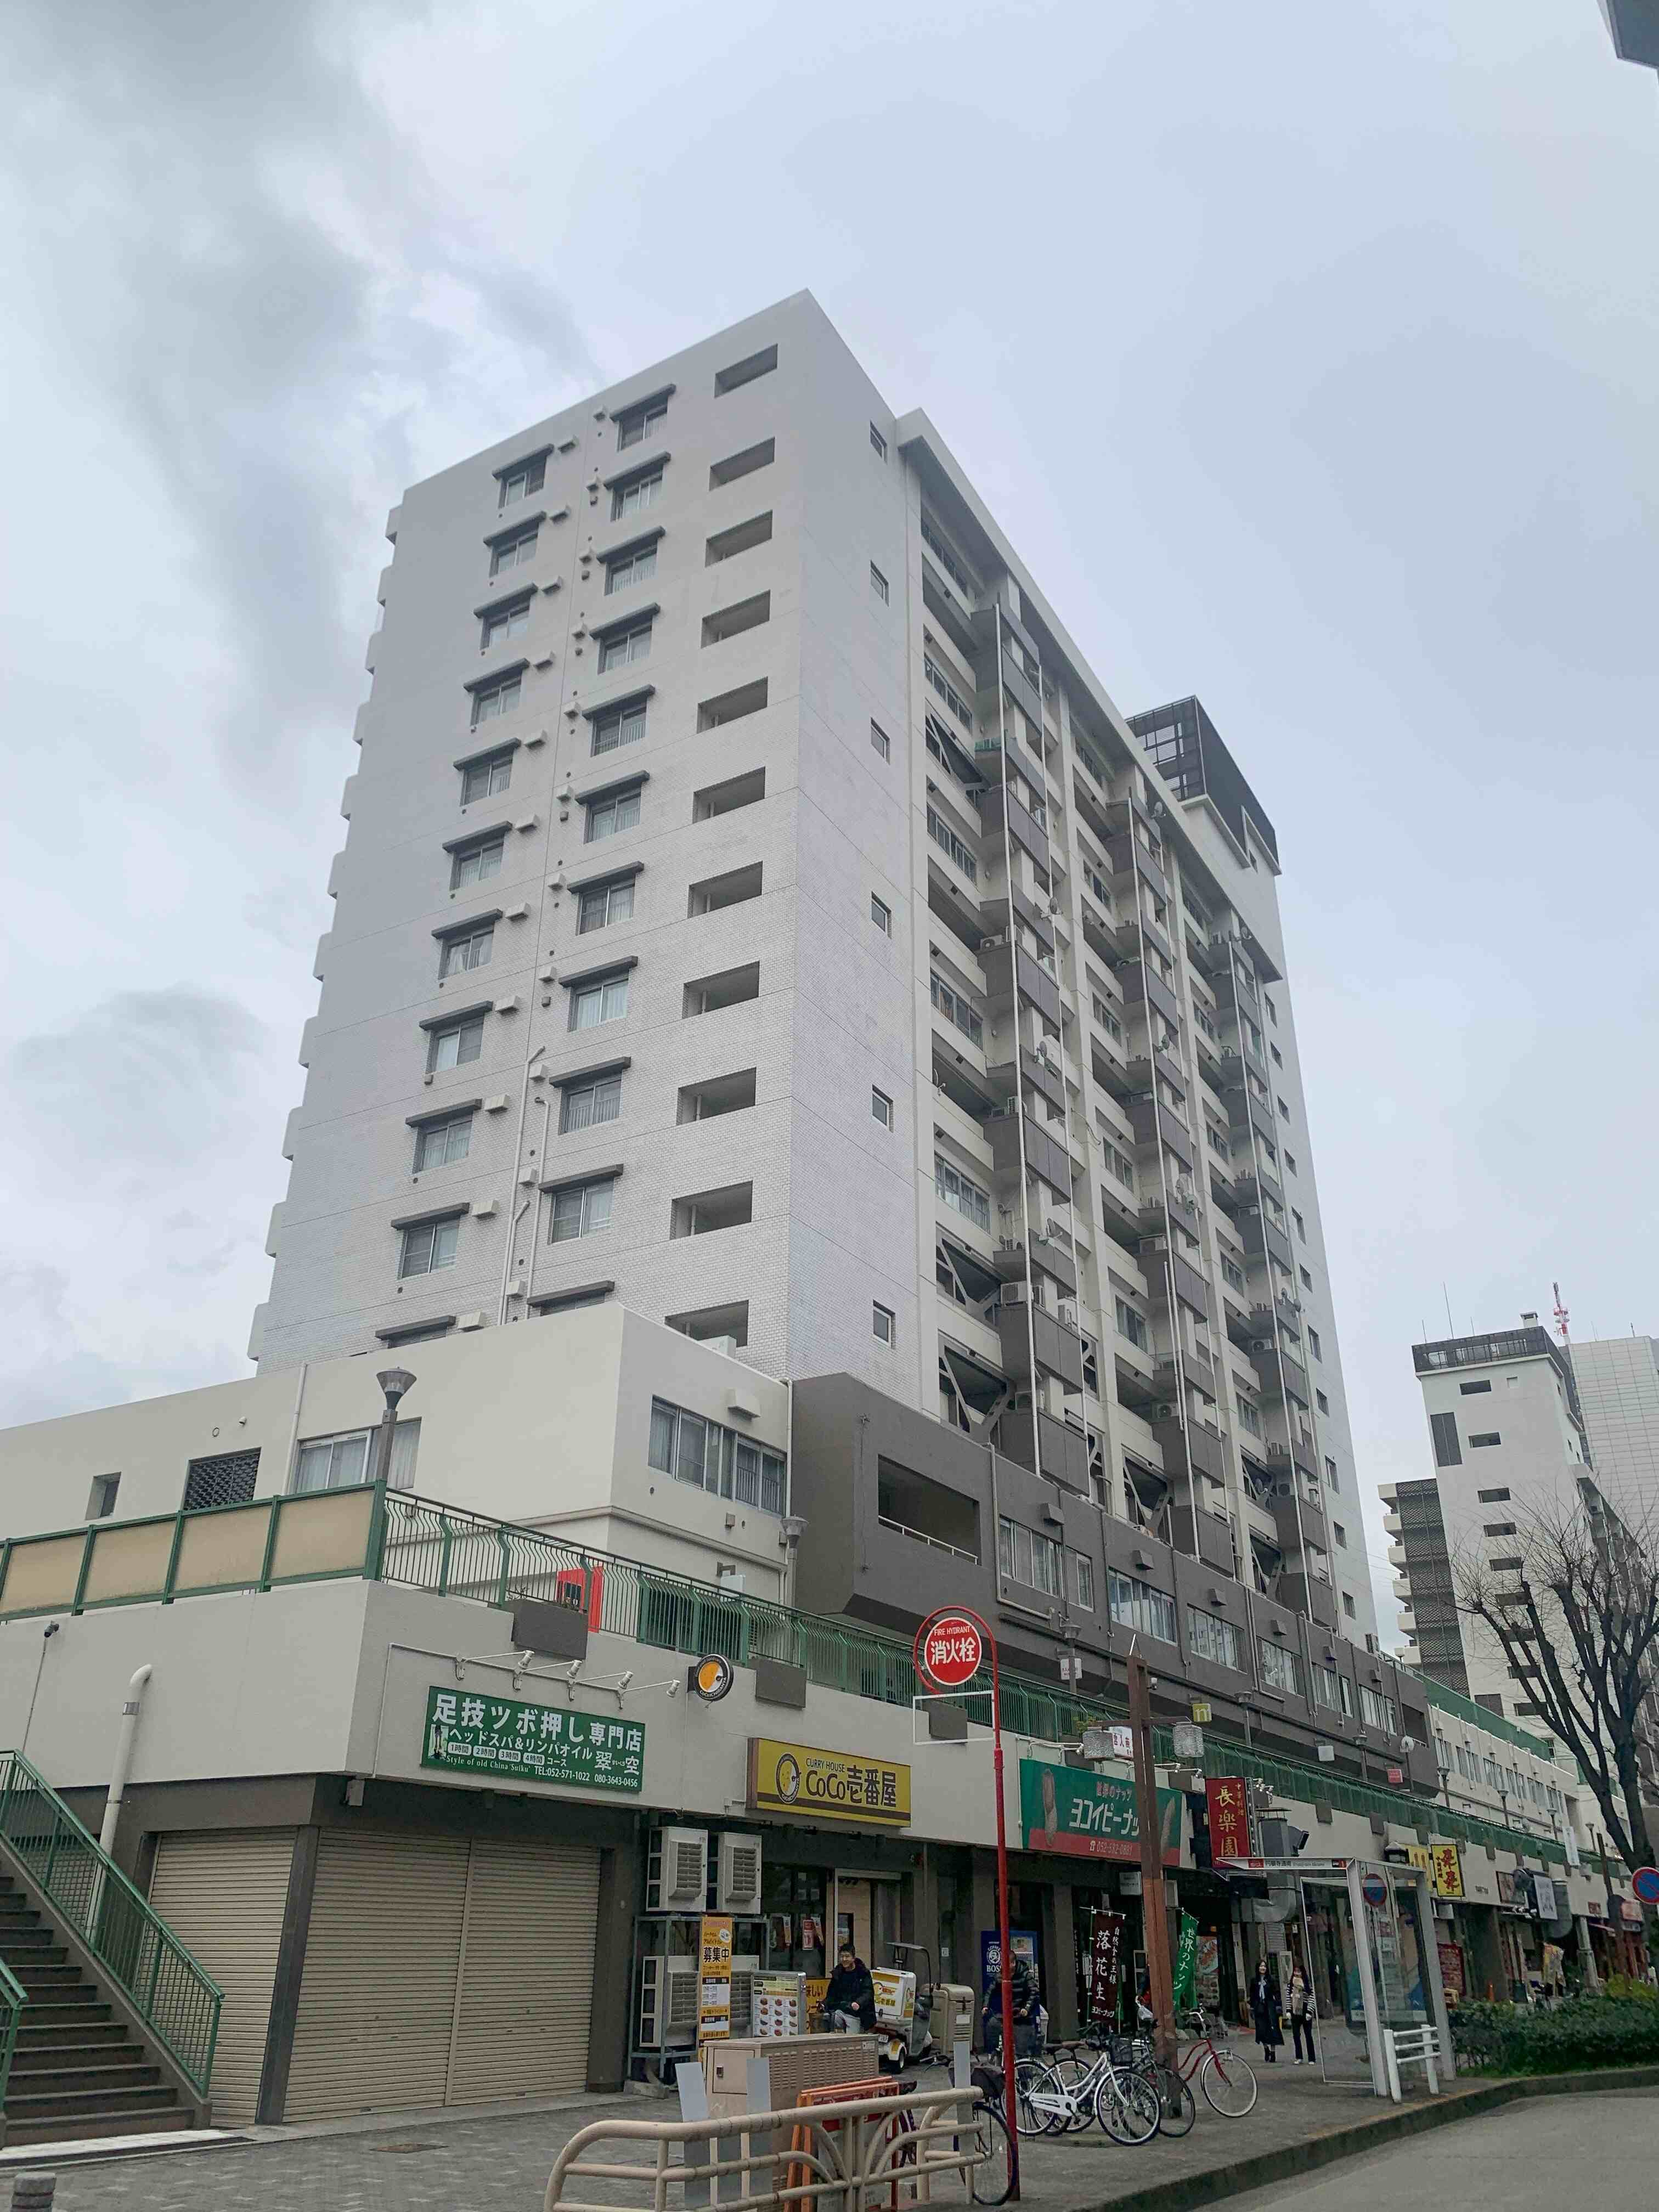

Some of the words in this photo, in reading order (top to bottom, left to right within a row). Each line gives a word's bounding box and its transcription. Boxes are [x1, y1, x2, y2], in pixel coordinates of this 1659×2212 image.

[947, 1626, 970, 1634] HYDRANT
[930, 1637, 976, 1665] 消火栓
[432, 1694, 642, 1752] 足技ツボ押し専門店
[449, 1728, 592, 1759] ヘッドスパ&リンパオイル
[451, 1743, 469, 1754] 1時間
[476, 1747, 494, 1757] 2時間
[500, 1751, 518, 1760] 3時間
[525, 1754, 543, 1764] 4時間
[547, 1757, 566, 1767] コース
[446, 1756, 464, 1765] Style
[477, 1759, 487, 1767] old
[490, 1760, 508, 1770] China
[806, 1758, 825, 1769] CURRY
[826, 1761, 845, 1773] HOUSE
[534, 1765, 590, 1781] TEL:052-571-1022
[594, 1774, 638, 1787] 080-3643-0456
[1069, 1798, 1139, 1836] ヨコイピーナッ
[703, 1946, 729, 1963] 募集中
[1095, 1930, 1111, 2001] 落花生
